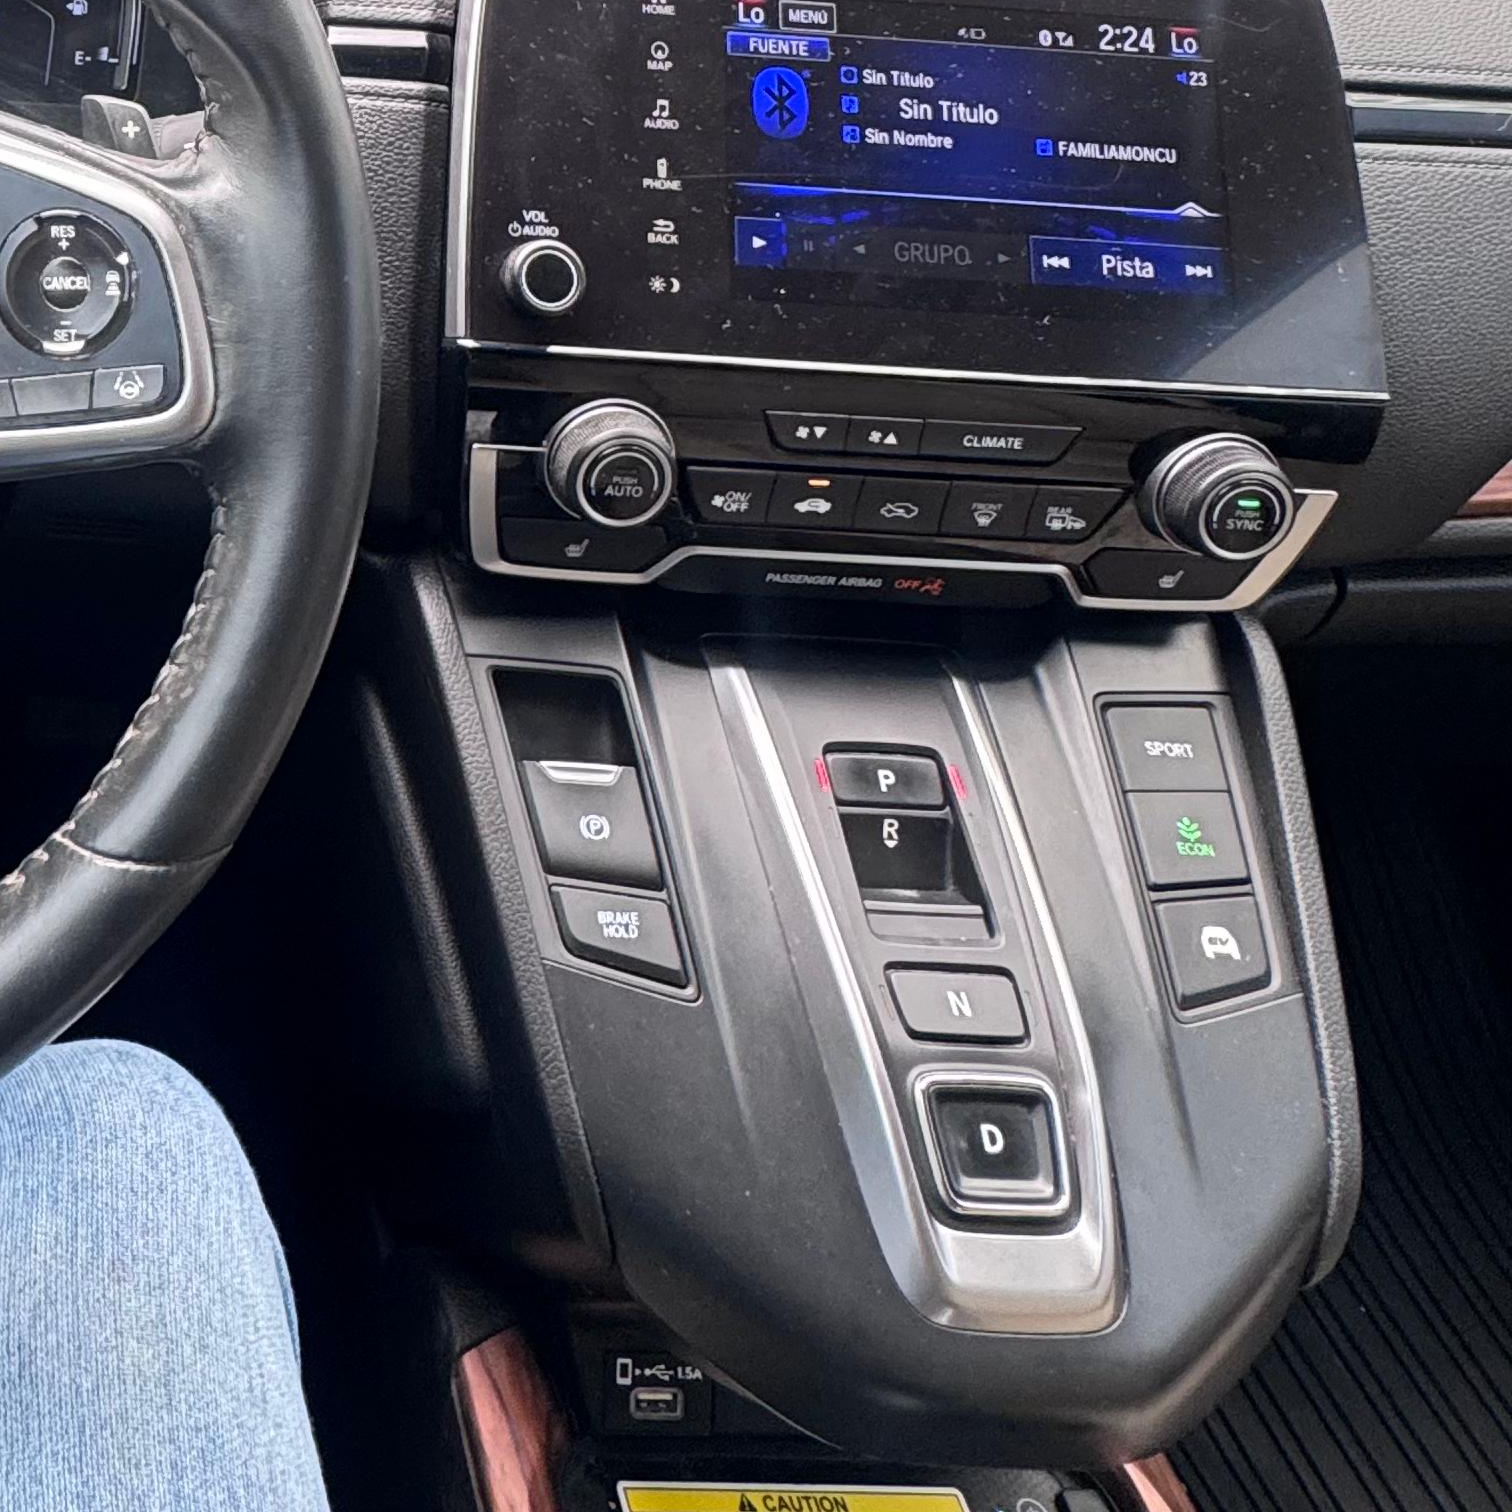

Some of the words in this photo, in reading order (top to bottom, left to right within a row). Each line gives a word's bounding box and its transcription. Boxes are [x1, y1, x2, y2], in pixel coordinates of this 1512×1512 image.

[641, 3, 676, 17] HOME
[737, 1, 765, 24] Lo
[1098, 23, 1155, 54] 2:24
[1170, 31, 1198, 54] Lo
[748, 37, 809, 57] FUENTE
[74, 50, 85, 66] E
[646, 59, 674, 72] MAP
[862, 68, 888, 86] Sin
[1188, 71, 1208, 87] 23
[899, 97, 933, 121] Sin
[644, 117, 680, 130] AUDIO
[864, 127, 890, 145] Sin
[892, 129, 953, 149] Nombre
[1058, 140, 1176, 164] FAMILIAMONCU
[642, 177, 683, 191] PHONE
[522, 209, 549, 223] VOL
[50, 224, 76, 238] RES
[522, 224, 560, 238] AUDIO
[647, 232, 679, 245] BACK
[894, 240, 971, 266] GRUPO
[1101, 254, 1155, 279] Pista
[42, 275, 91, 292] CANCEL
[52, 328, 78, 342] SET
[963, 434, 1024, 450] CLIMATE
[612, 476, 638, 485] PUSH
[603, 485, 643, 498] AUTO
[723, 501, 750, 512] OFF
[971, 502, 1004, 511] FRONT
[1047, 506, 1073, 515] REAR
[1226, 518, 1265, 532] SYNC
[766, 572, 837, 586] PASSENGER
[838, 576, 883, 589] AIRBAG
[894, 578, 921, 590] OFF
[1144, 740, 1194, 758] SPORT
[876, 768, 897, 794] P
[882, 818, 900, 840] R
[1175, 840, 1216, 858] ECON
[597, 910, 639, 925] BRAKE
[602, 924, 639, 938] HOLD
[945, 989, 973, 1018] N
[979, 1122, 1005, 1155] D
[761, 1494, 850, 1512] CAUTION
